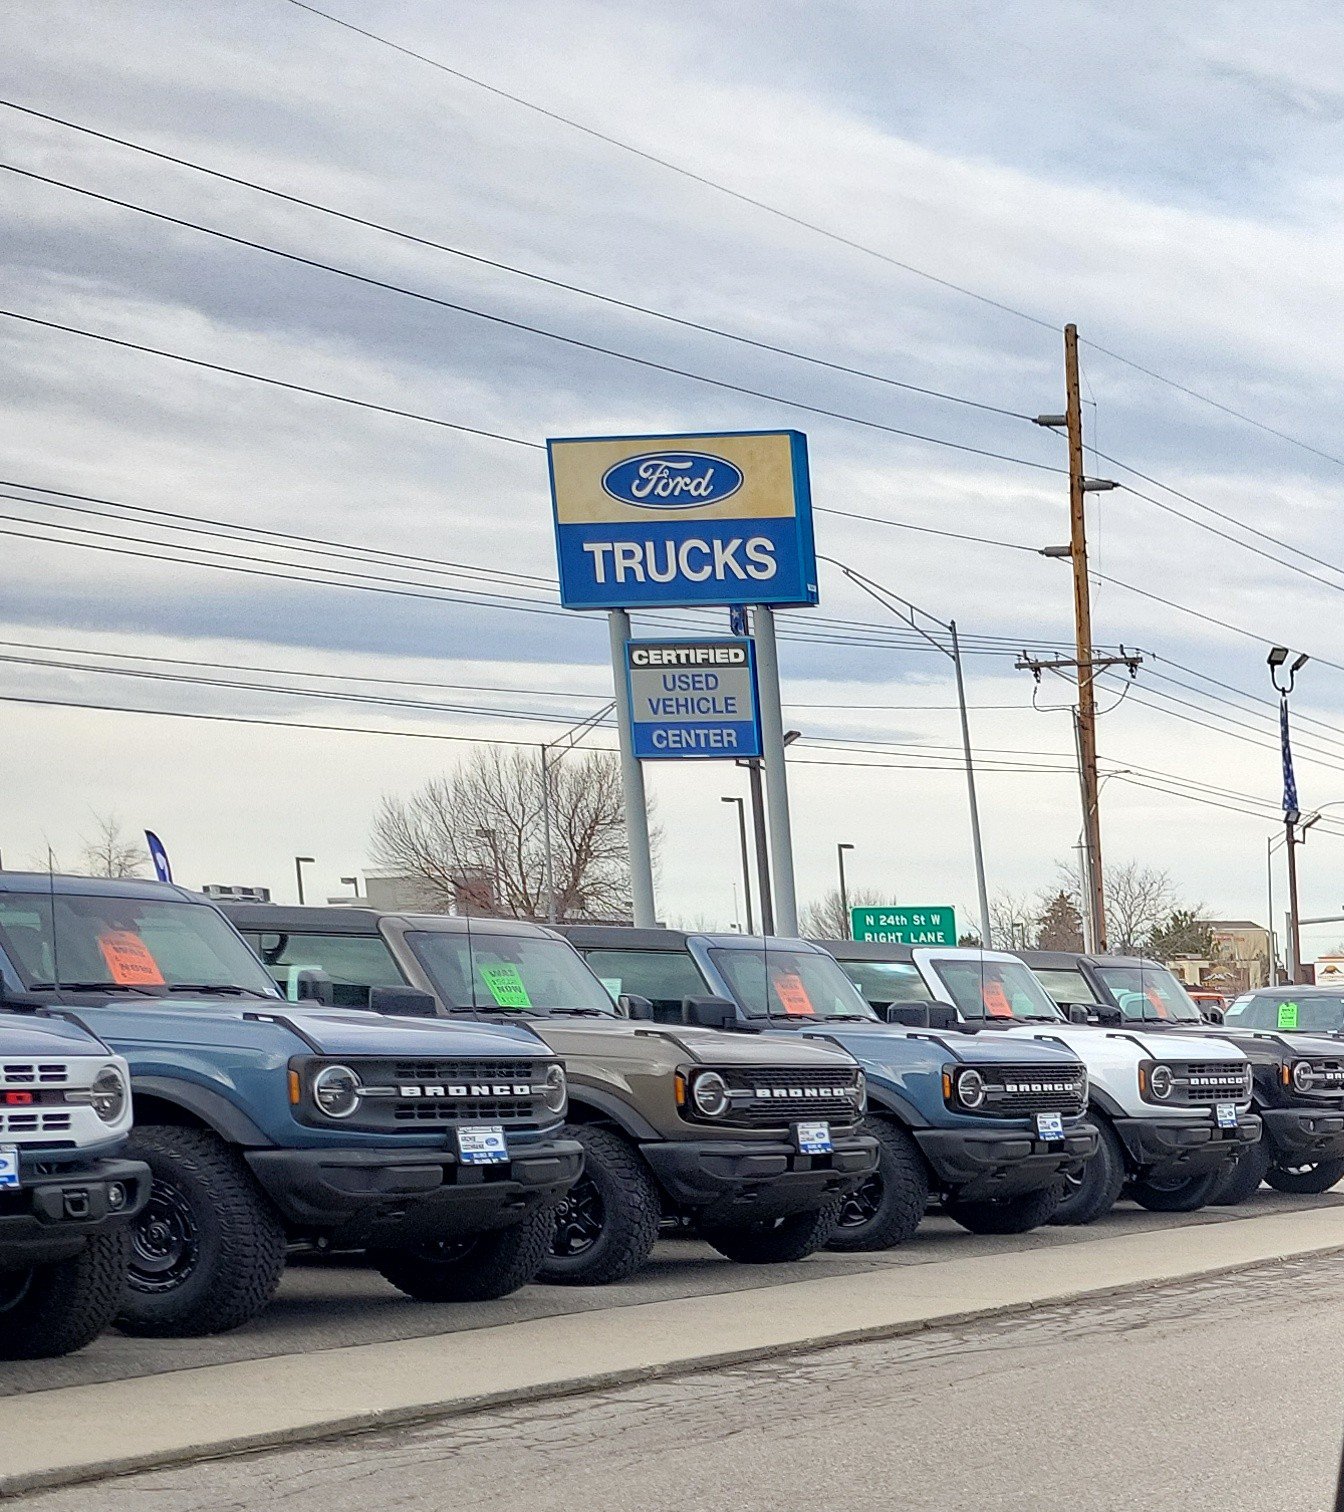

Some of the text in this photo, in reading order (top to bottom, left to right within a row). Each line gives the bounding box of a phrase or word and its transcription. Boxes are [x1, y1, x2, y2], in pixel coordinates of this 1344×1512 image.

[630, 460, 715, 498] Ford
[583, 537, 777, 584] TRUCKS
[632, 647, 746, 666] CERTIFIED
[662, 673, 719, 692] USED
[648, 697, 738, 716] VEHICLE
[652, 729, 738, 748] CENTER
[865, 914, 941, 926] N 24th St W
[864, 932, 945, 943] RIGHT LANE
[1005, 1083, 1073, 1092] BRONCO
[1190, 1077, 1243, 1085] BRONCO
[400, 1085, 530, 1097] BRONCO
[756, 1088, 845, 1098] BRONCO
